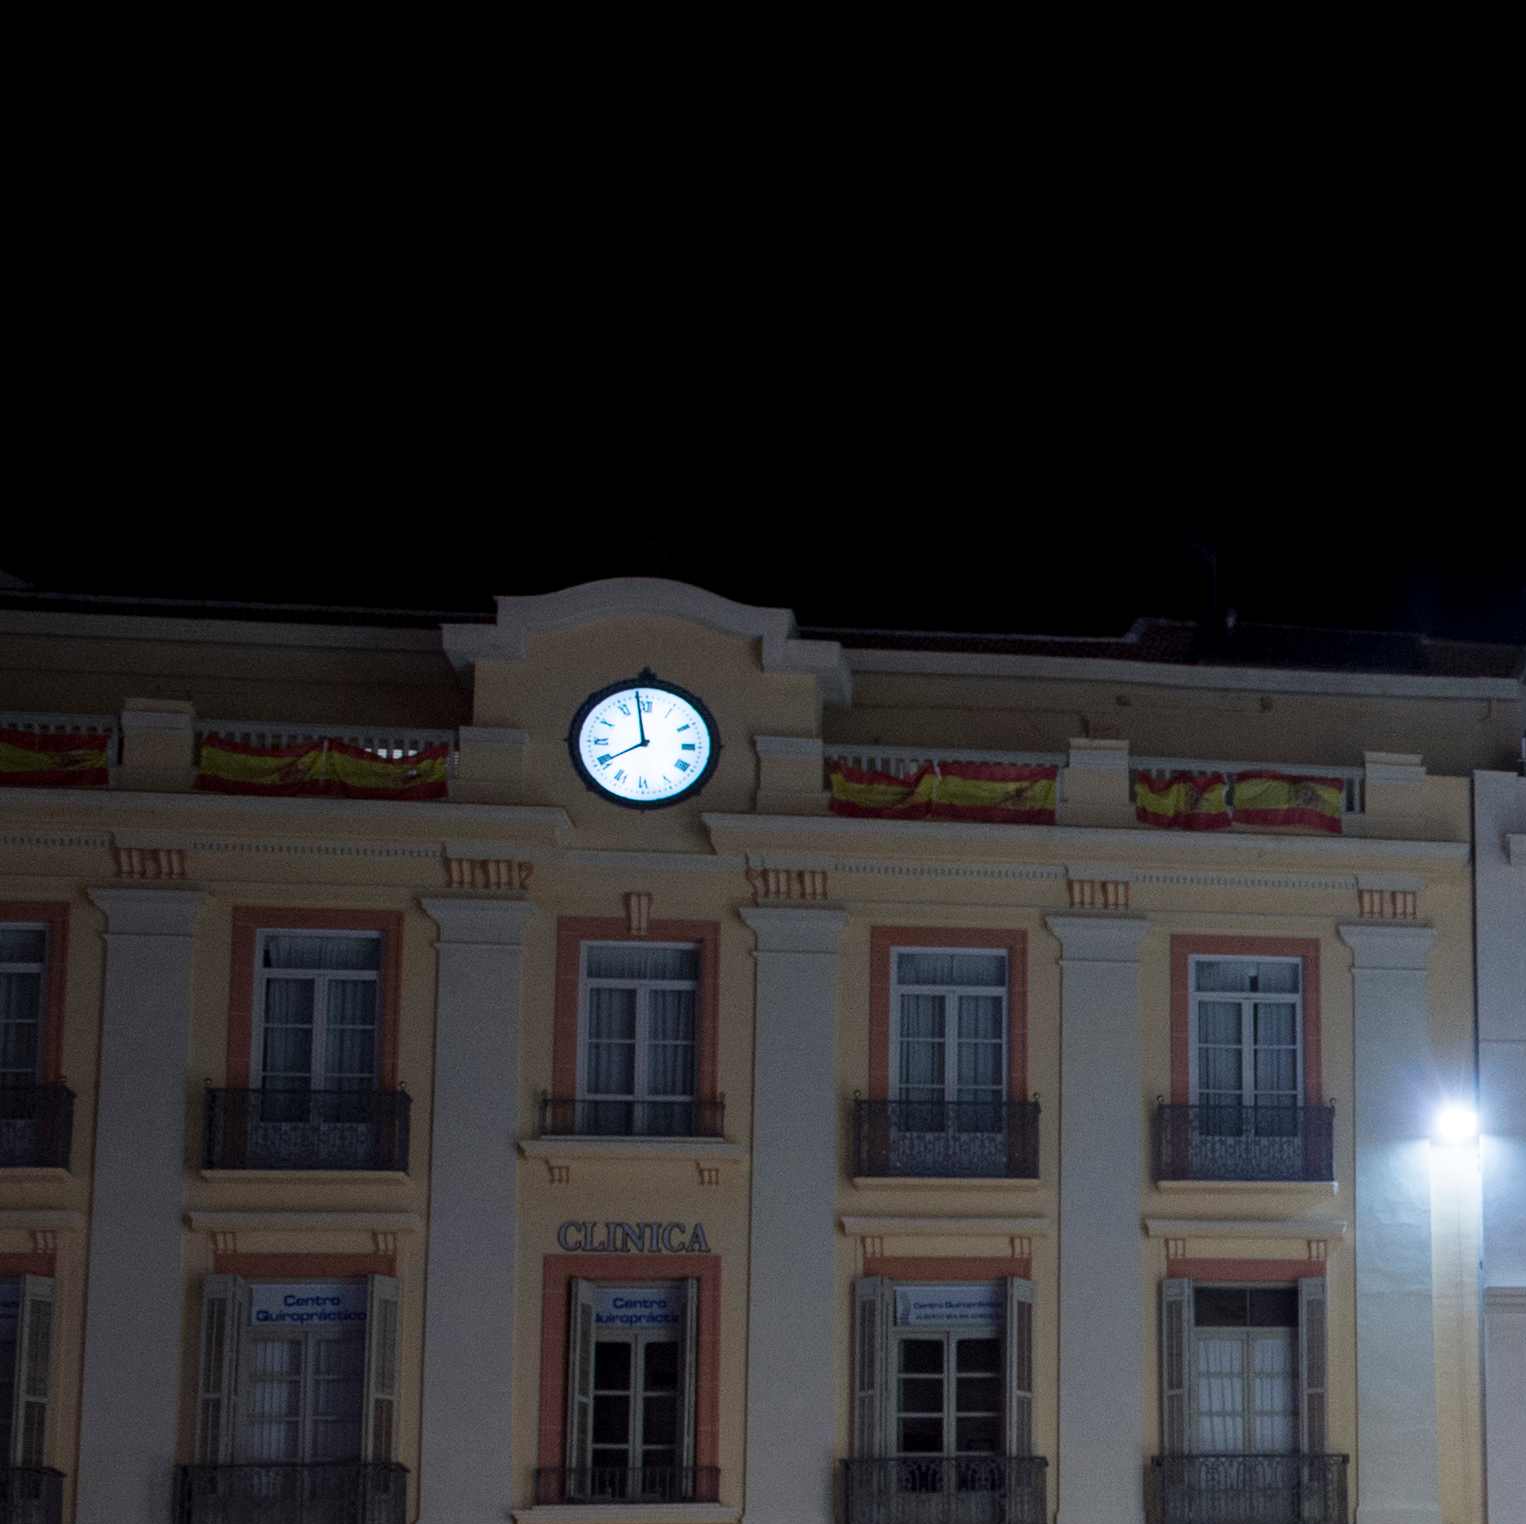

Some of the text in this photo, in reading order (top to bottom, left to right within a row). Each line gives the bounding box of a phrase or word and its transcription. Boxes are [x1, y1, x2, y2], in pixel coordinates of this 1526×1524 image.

[557, 1220, 711, 1253] CLINICA
[283, 1294, 341, 1307] Centro
[612, 1297, 667, 1310] Centro
